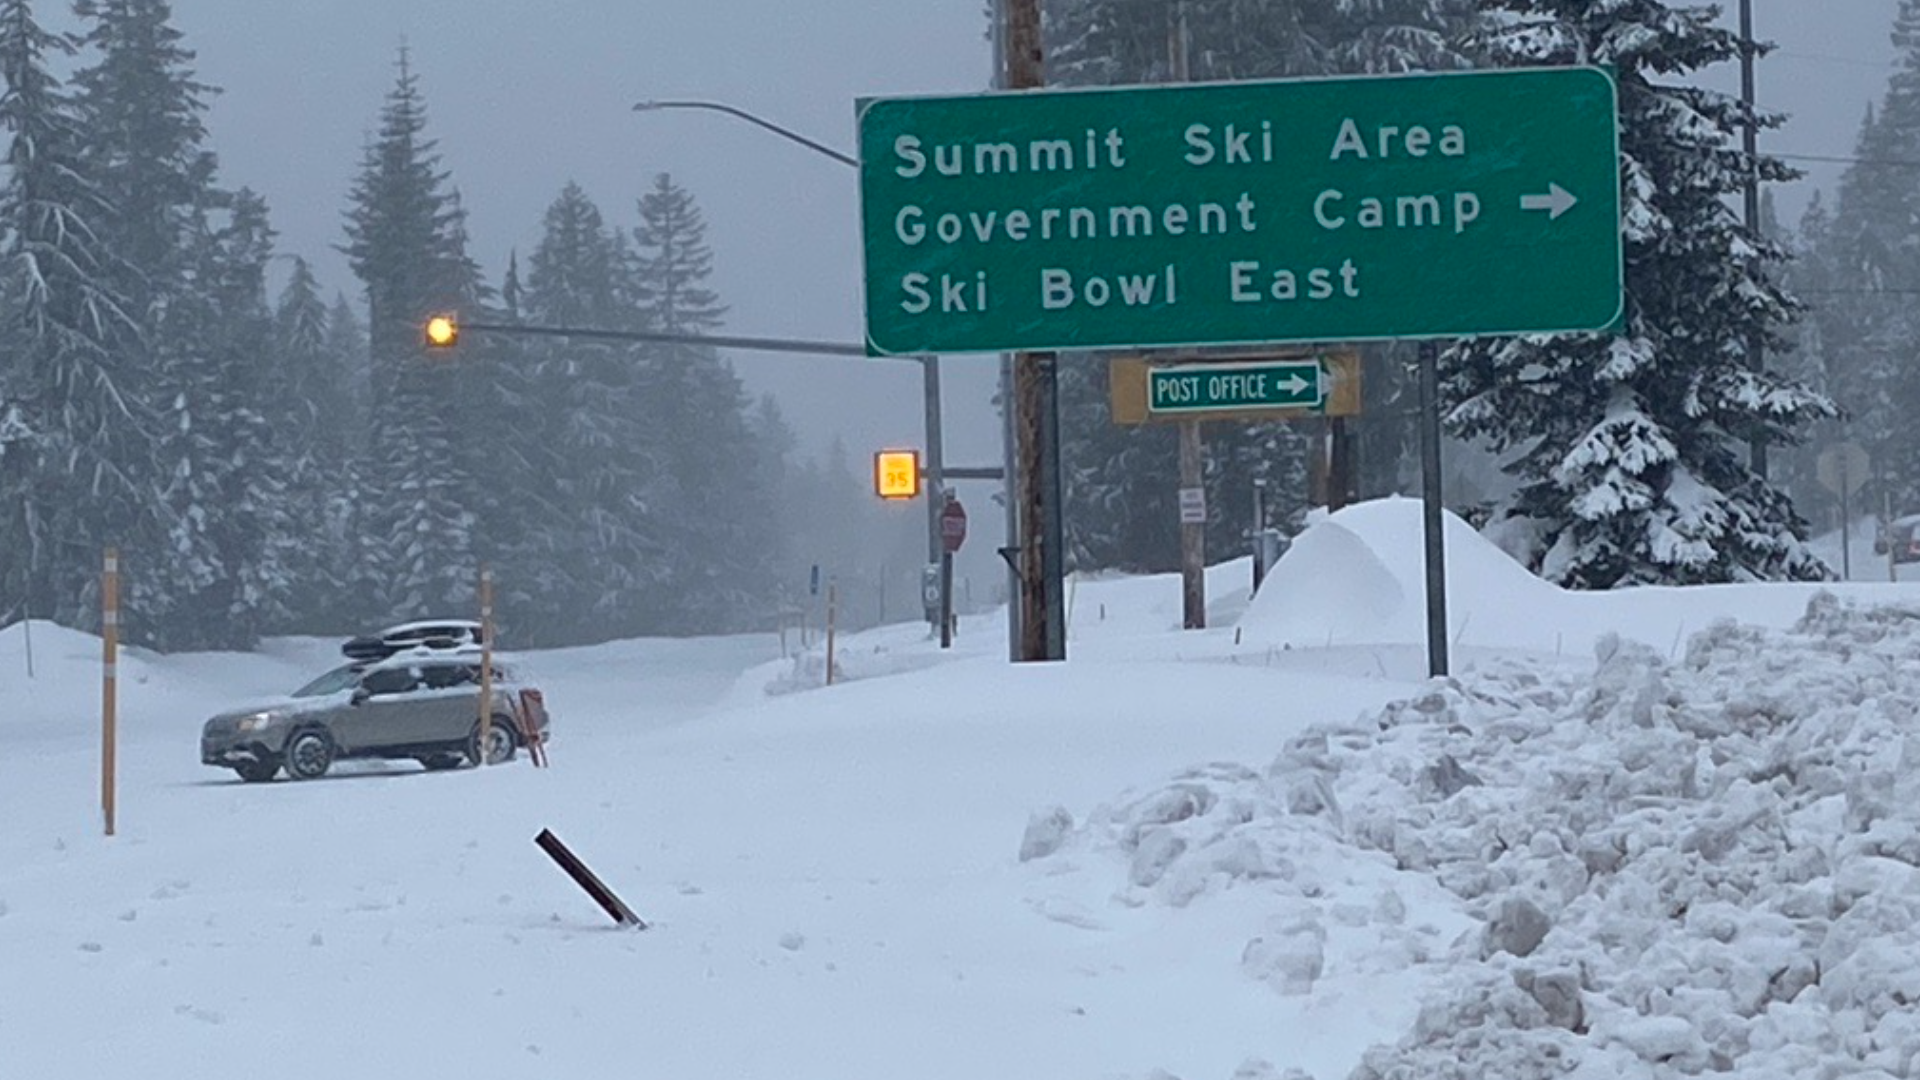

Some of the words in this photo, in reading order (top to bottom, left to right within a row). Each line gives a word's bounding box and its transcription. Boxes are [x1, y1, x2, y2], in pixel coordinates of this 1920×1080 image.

[894, 129, 1126, 178] Summit
[1183, 119, 1275, 165] Ski
[1331, 117, 1467, 160] Area
[895, 192, 1258, 246] Government
[1313, 189, 1481, 234] Camp
[901, 270, 989, 314] Ski
[1041, 263, 1177, 309] Bowl
[1230, 258, 1361, 303] East
[1157, 377, 1200, 403] POST
[1208, 374, 1267, 400] OFFICE
